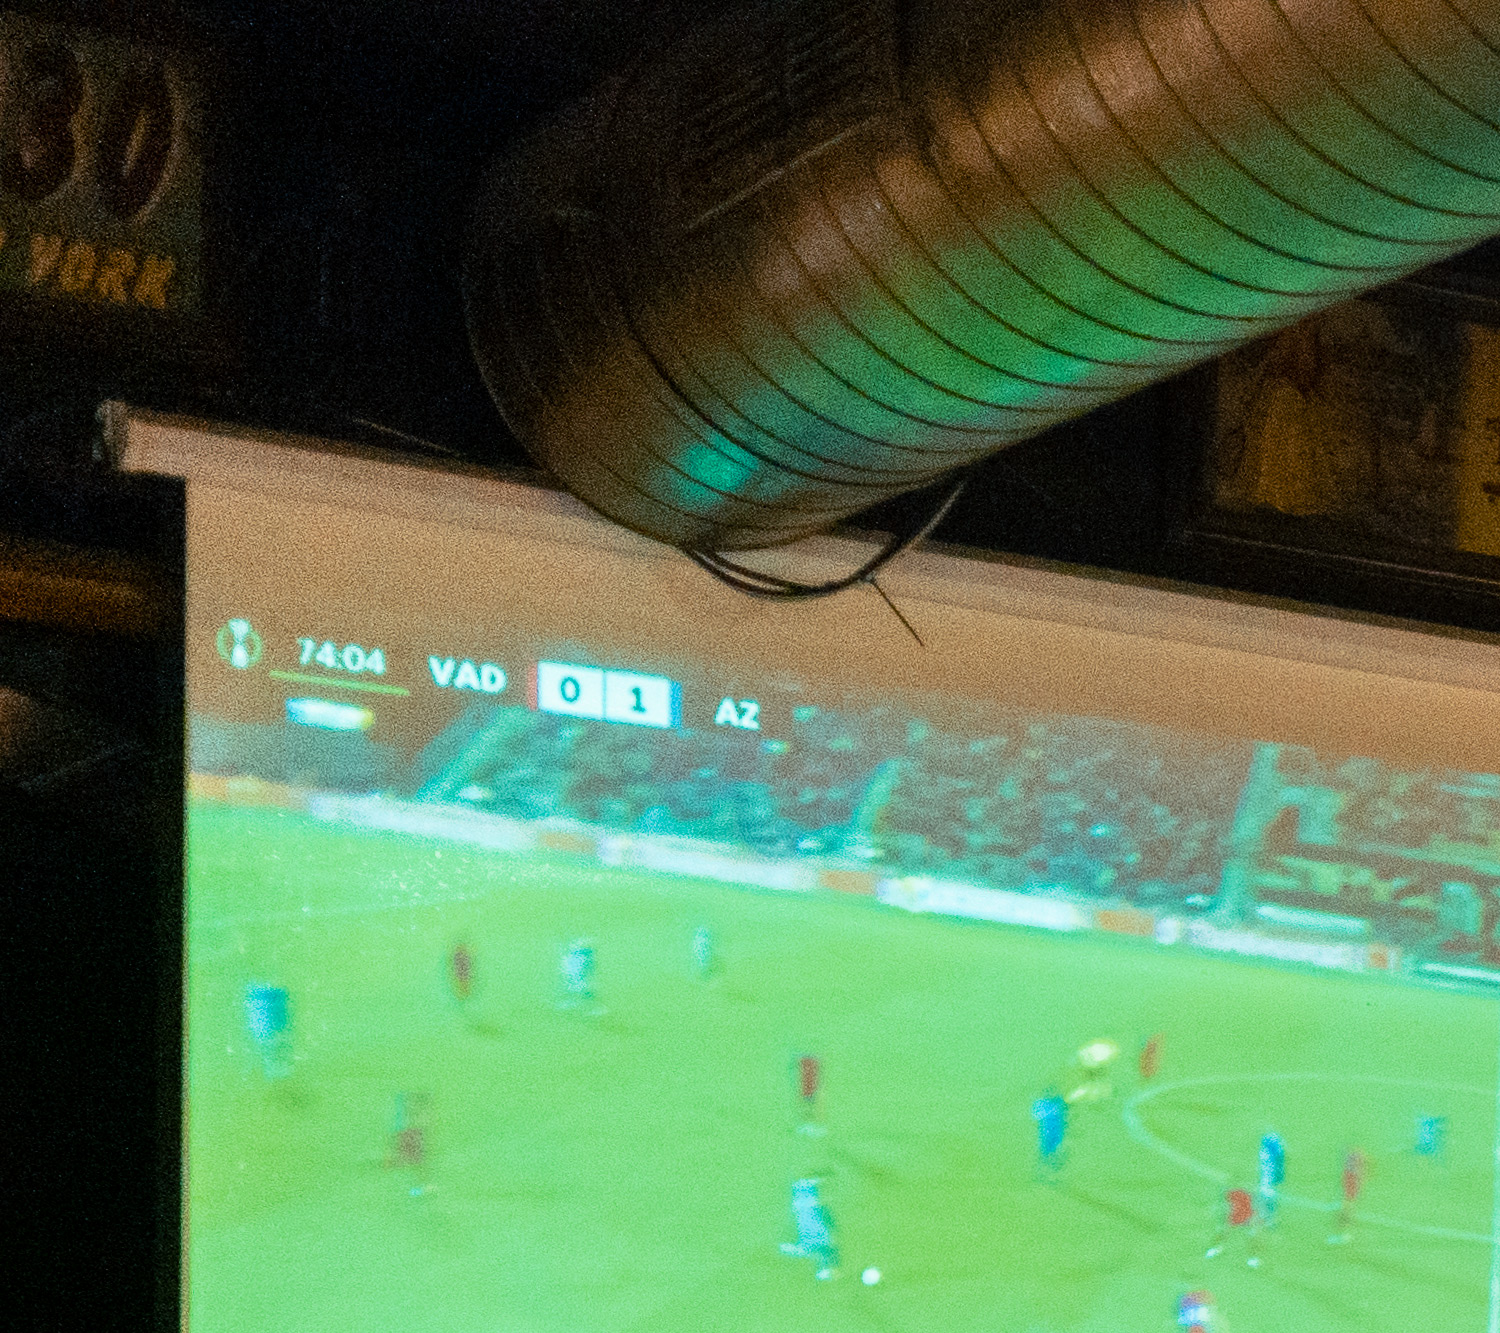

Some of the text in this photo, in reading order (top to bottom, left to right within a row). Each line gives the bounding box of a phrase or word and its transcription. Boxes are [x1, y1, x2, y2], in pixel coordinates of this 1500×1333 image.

[30, 233, 174, 309] YORK
[298, 636, 760, 731] 74:04 VAD 0 1 AZ
